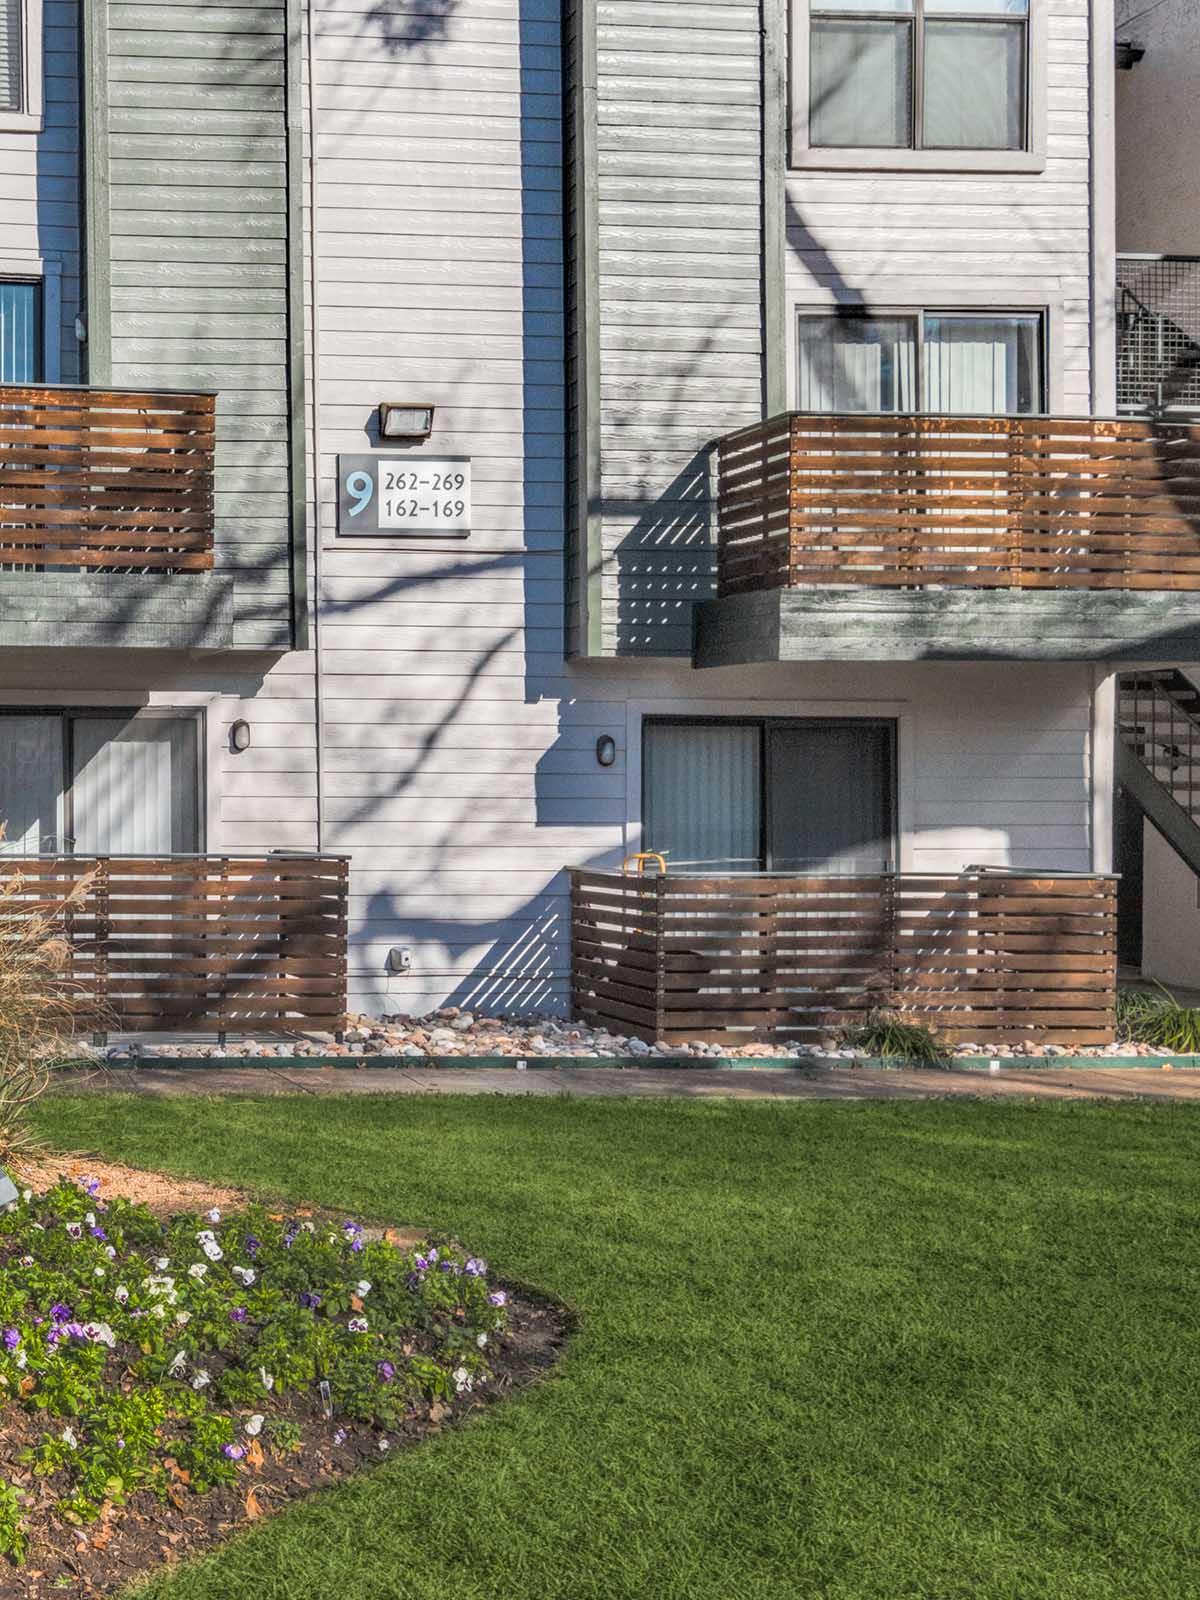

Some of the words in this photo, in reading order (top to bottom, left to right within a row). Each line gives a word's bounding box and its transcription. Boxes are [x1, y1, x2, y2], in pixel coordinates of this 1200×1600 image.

[385, 473, 465, 490] 262-269
[347, 472, 373, 517] 9
[385, 500, 465, 517] 162-169
